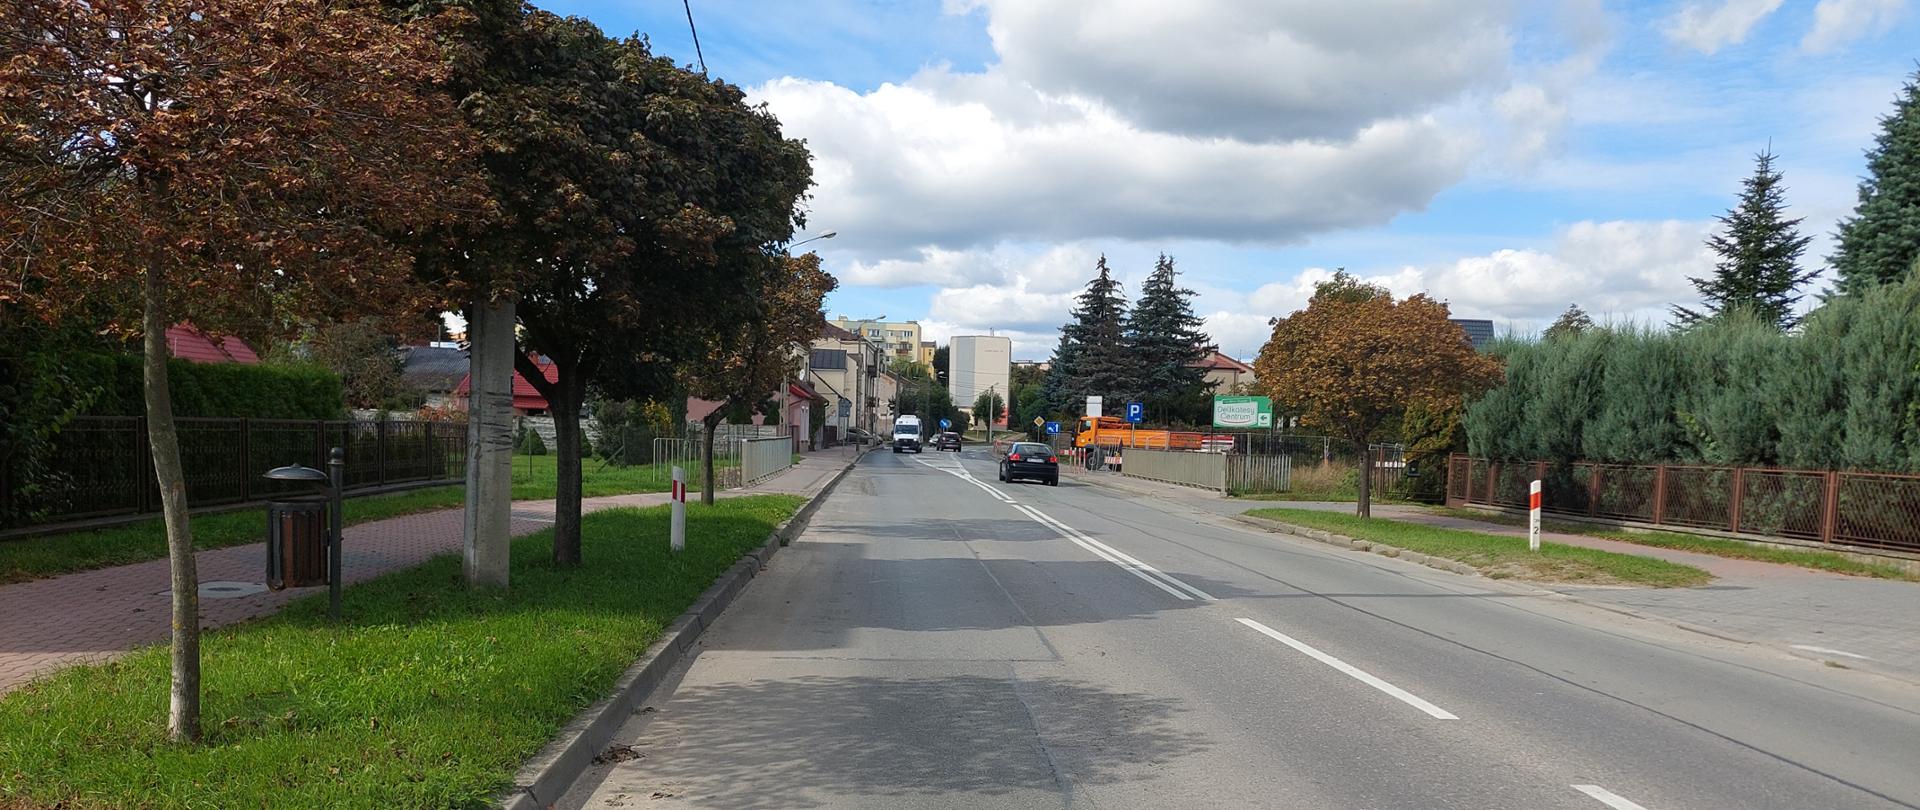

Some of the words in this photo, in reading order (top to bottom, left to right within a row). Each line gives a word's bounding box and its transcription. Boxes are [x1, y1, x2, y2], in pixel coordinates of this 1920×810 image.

[1130, 404, 1140, 417] P
[1217, 406, 1255, 415] Delikatesy
[1220, 412, 1251, 420] Centrum
[1533, 526, 1540, 535] 2
